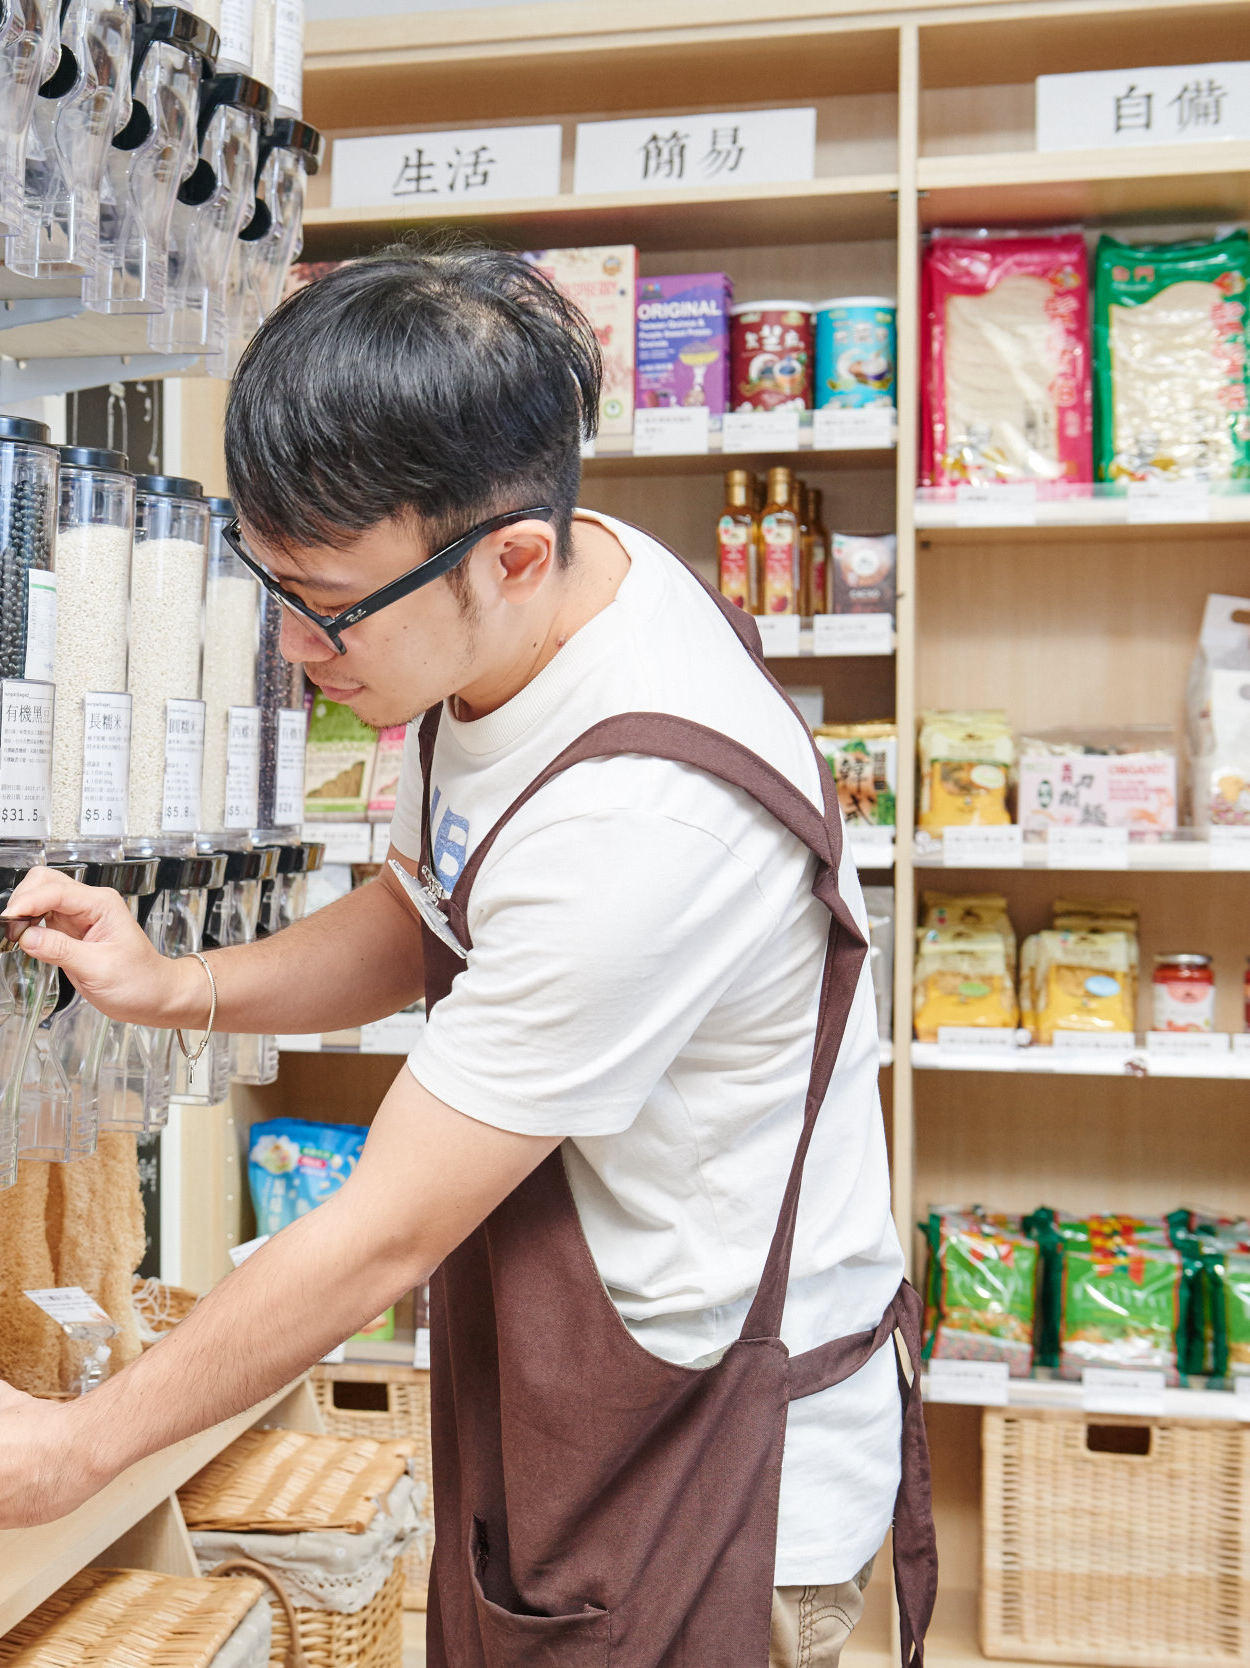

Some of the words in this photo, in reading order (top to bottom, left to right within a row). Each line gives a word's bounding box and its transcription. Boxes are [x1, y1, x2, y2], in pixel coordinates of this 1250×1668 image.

[1113, 79, 1229, 134] 自備
[640, 125, 746, 181] 簡易
[391, 145, 496, 197] 生活
[637, 299, 722, 321] ORIGINAL
[5, 704, 52, 724] 有機黑豆
[1, 808, 38, 823] $31.5
[85, 808, 113, 822] $5.8
[166, 805, 190, 818] $5.8
